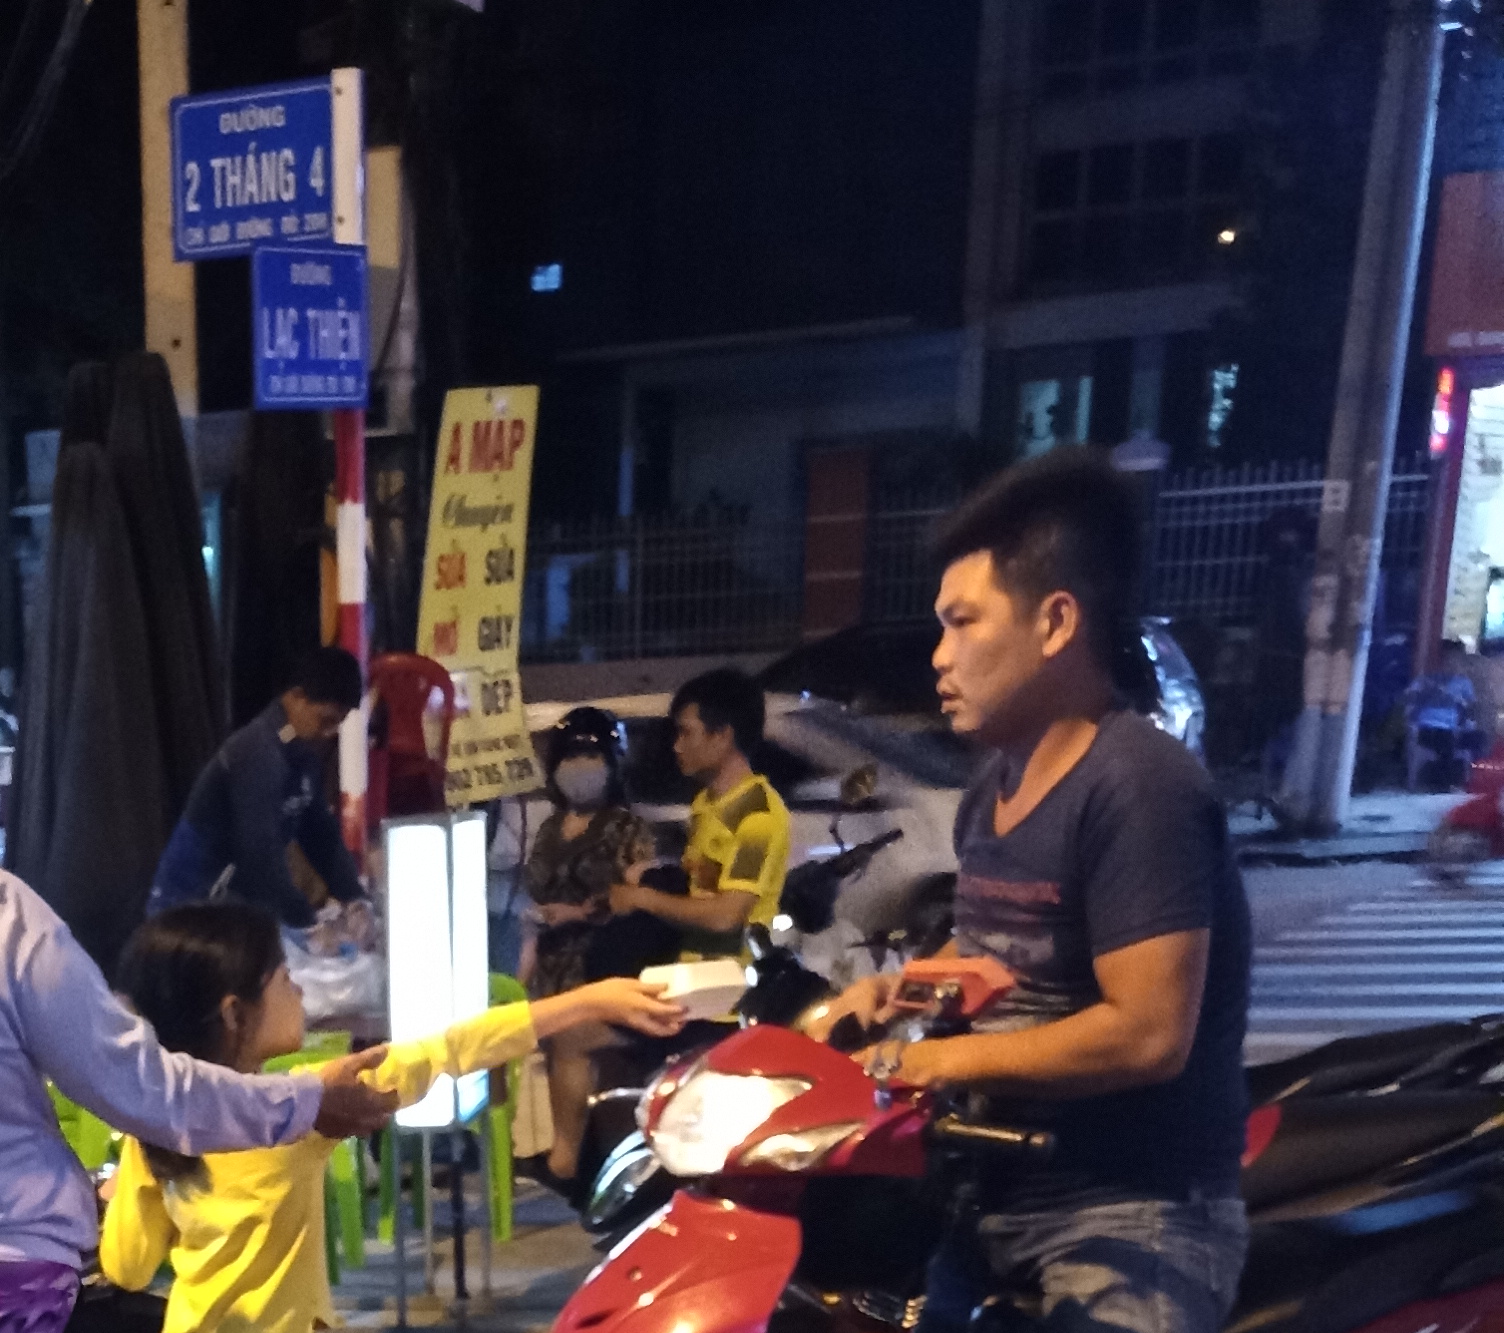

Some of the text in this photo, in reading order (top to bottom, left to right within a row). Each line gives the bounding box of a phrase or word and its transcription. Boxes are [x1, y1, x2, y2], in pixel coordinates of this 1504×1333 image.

[185, 141, 325, 212] 2 THÁNG 4
